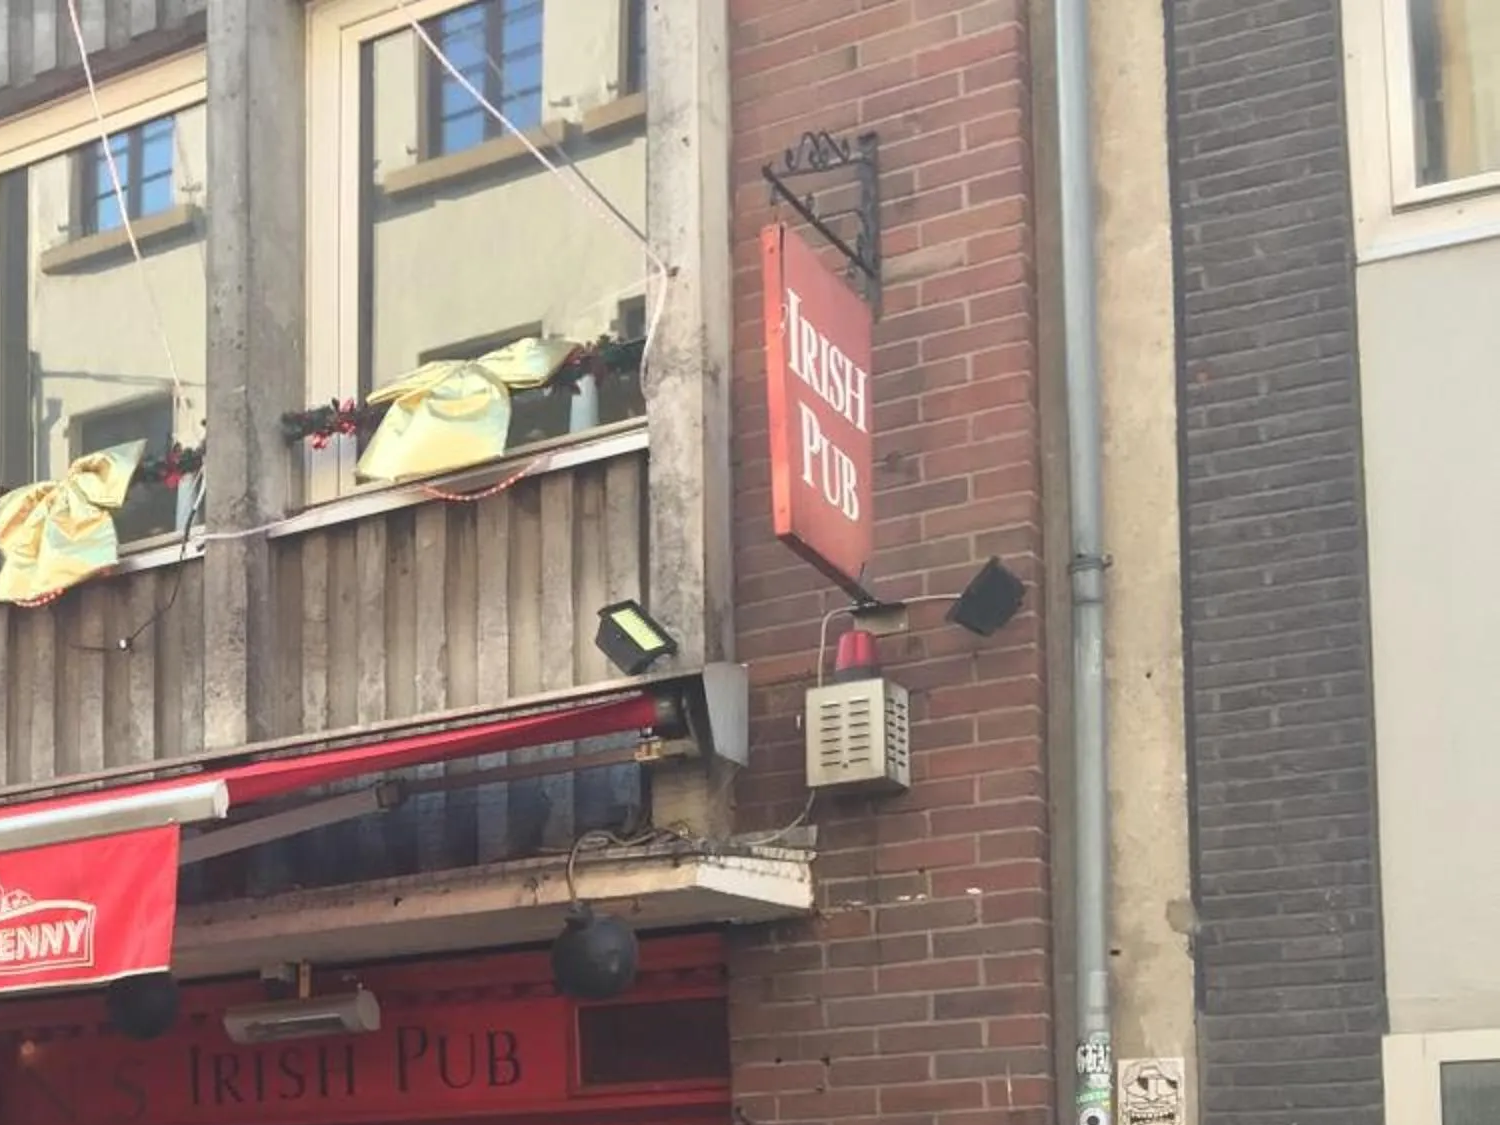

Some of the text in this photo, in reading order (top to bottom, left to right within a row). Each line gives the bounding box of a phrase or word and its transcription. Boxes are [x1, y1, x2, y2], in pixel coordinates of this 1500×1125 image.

[786, 287, 869, 434] IRISH
[799, 399, 860, 523] PUB
[189, 1044, 356, 1105] IRISH
[395, 1025, 521, 1094] PUB
